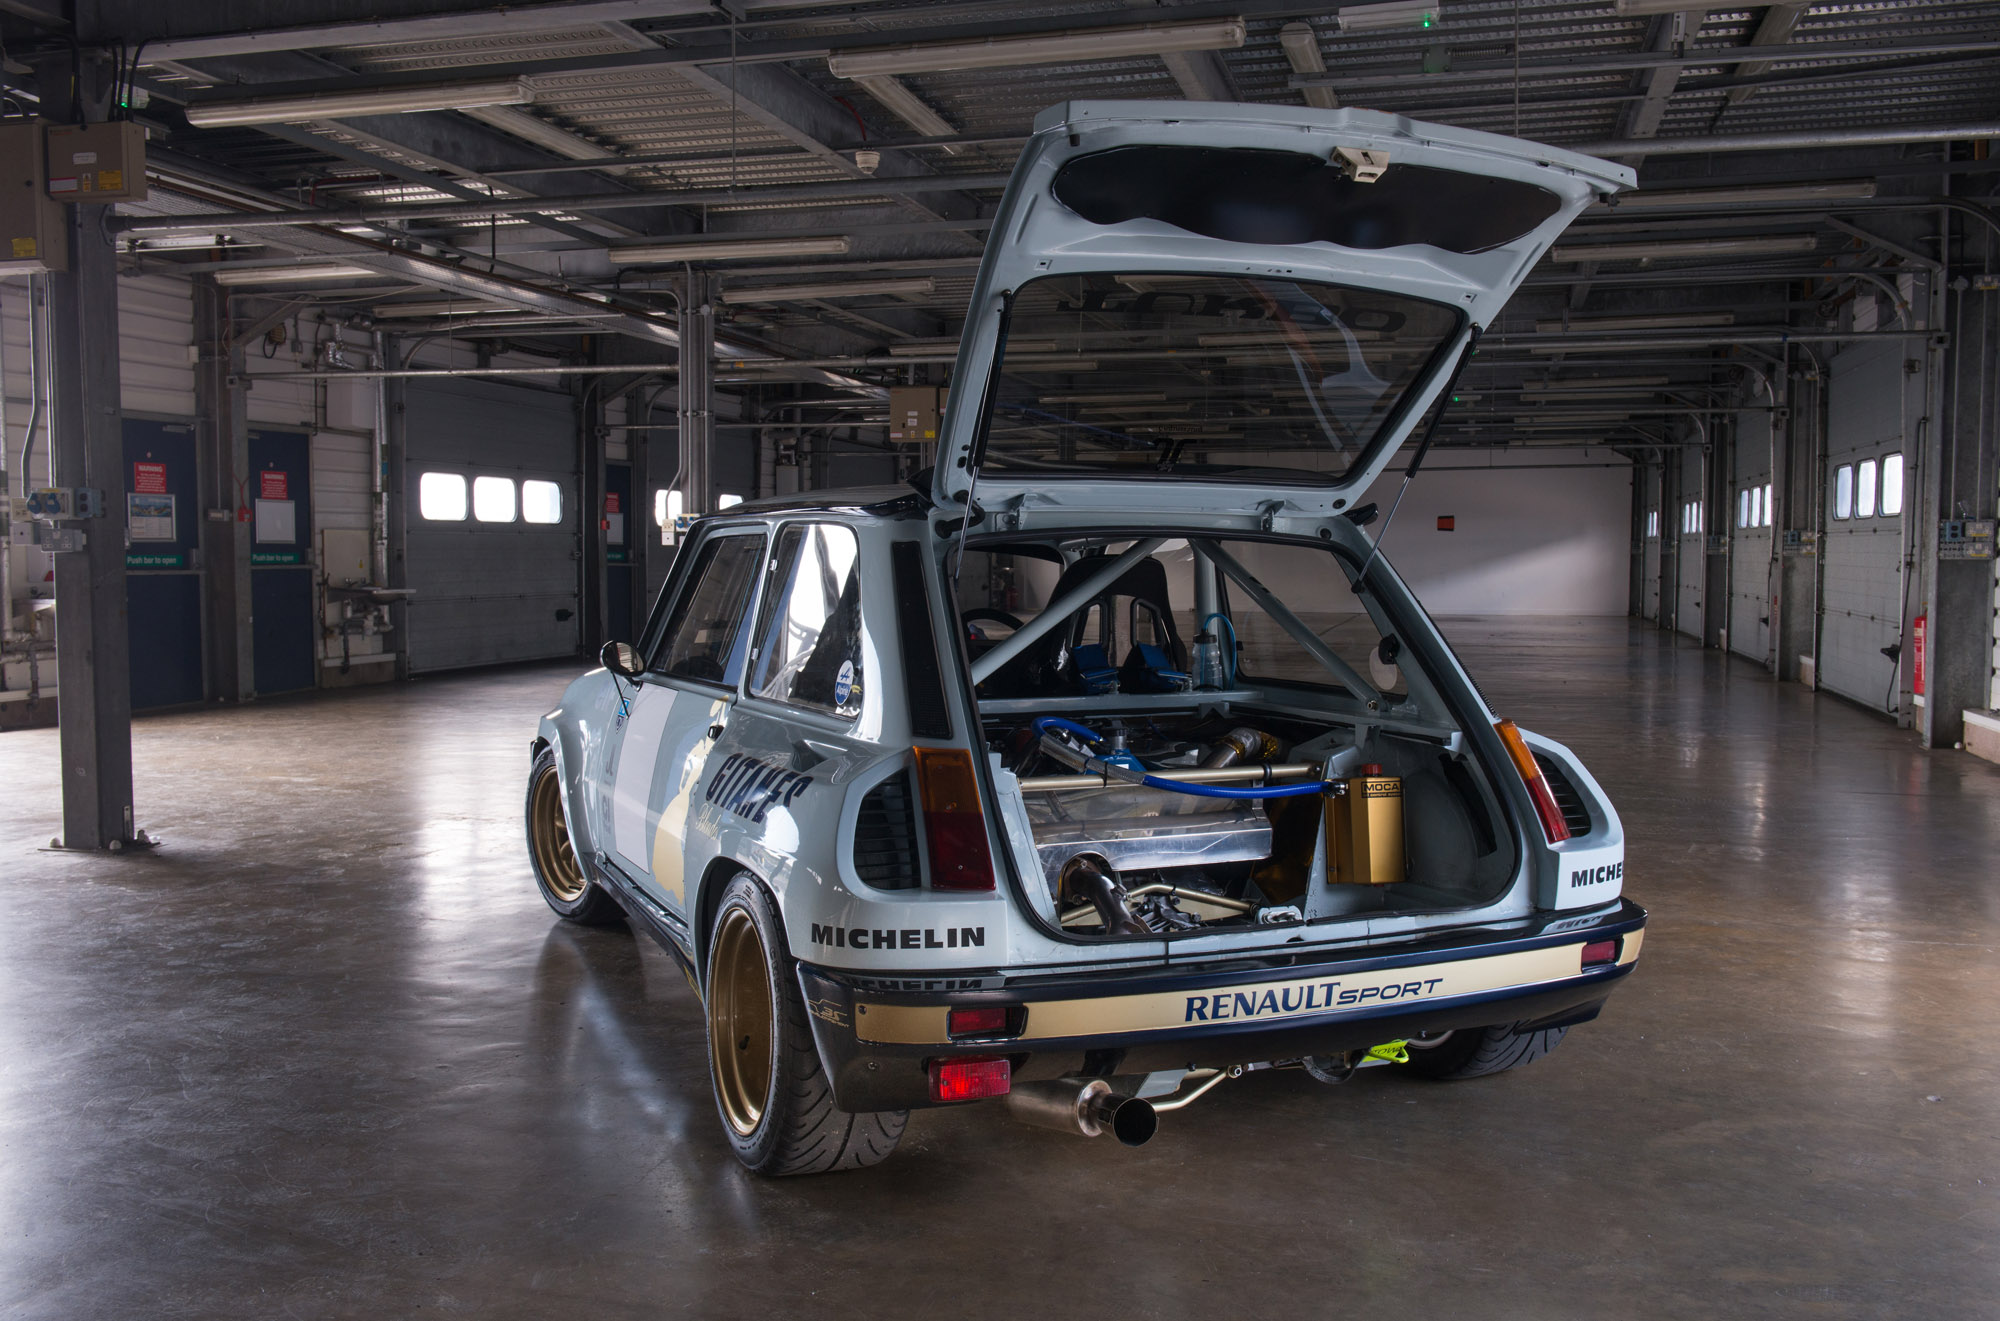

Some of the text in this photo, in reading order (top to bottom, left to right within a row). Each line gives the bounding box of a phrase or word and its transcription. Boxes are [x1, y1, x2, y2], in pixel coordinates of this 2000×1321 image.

[127, 556, 177, 566] Push bar to open
[706, 752, 814, 824] GITANES
[811, 923, 985, 949] MICHELIN
